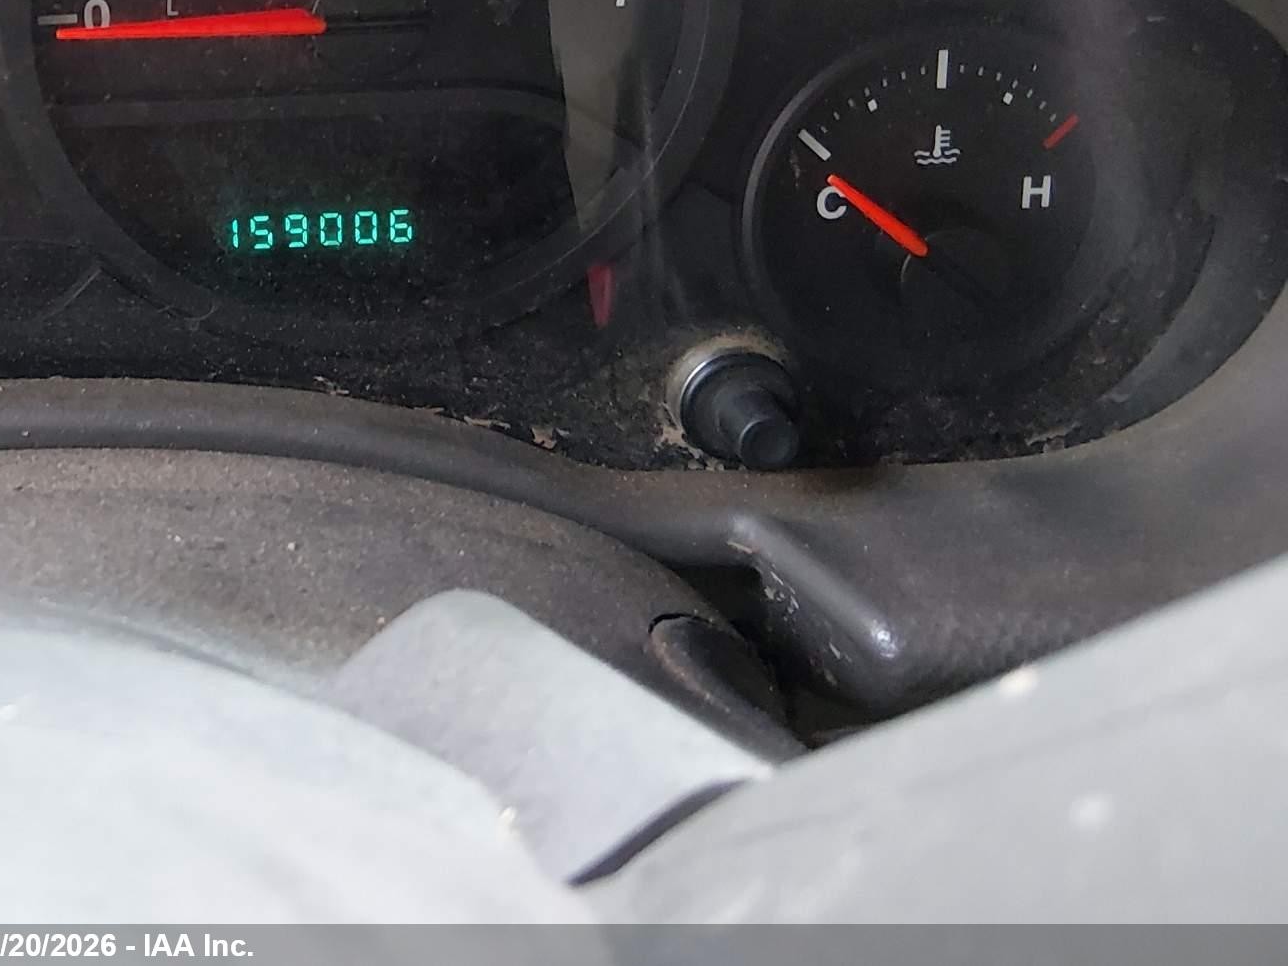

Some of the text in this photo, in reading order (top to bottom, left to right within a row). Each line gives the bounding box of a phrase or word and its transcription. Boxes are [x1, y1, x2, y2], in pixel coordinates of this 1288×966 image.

[816, 185, 848, 220] C
[1021, 175, 1052, 210] H
[231, 209, 413, 249] 159006
